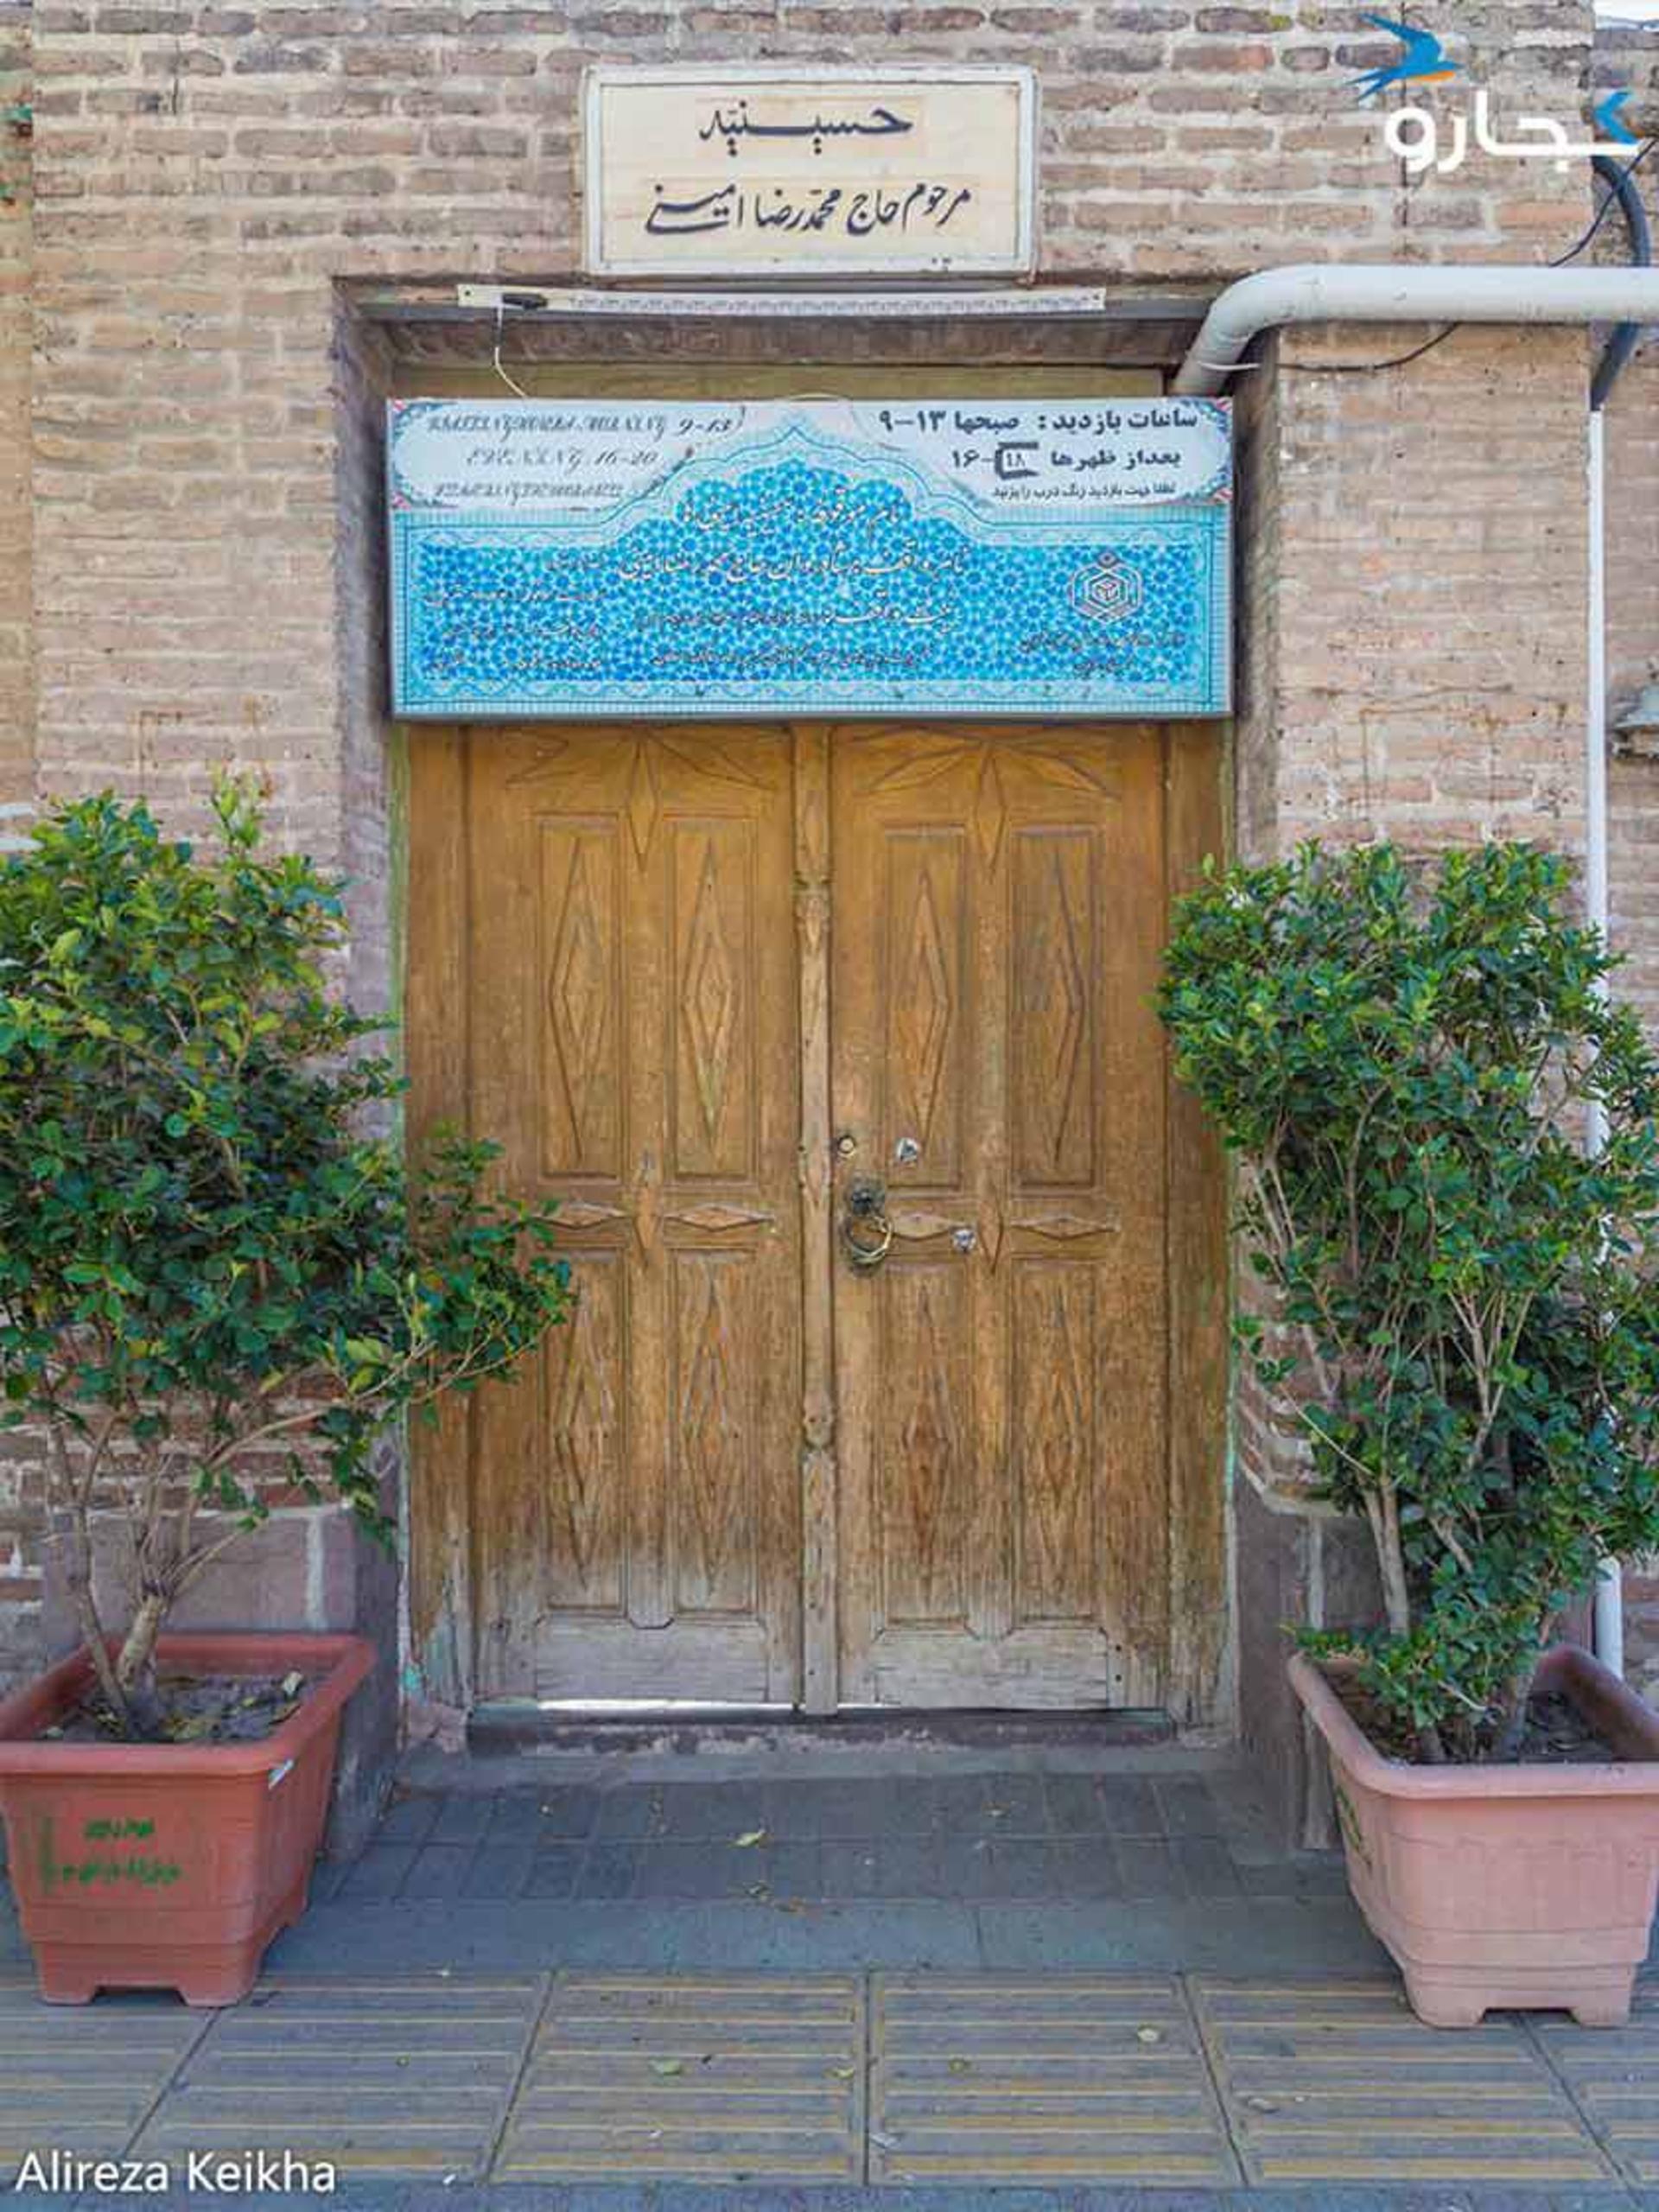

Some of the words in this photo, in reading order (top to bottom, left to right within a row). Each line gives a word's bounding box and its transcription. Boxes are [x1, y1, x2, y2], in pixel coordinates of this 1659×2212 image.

[644, 183, 746, 235] امینی
[845, 188, 899, 236] حاج
[902, 181, 972, 232] مرحوم
[954, 410, 1020, 434] صبحها
[1052, 410, 1122, 434] بازدید
[1128, 410, 1198, 429] ساعات
